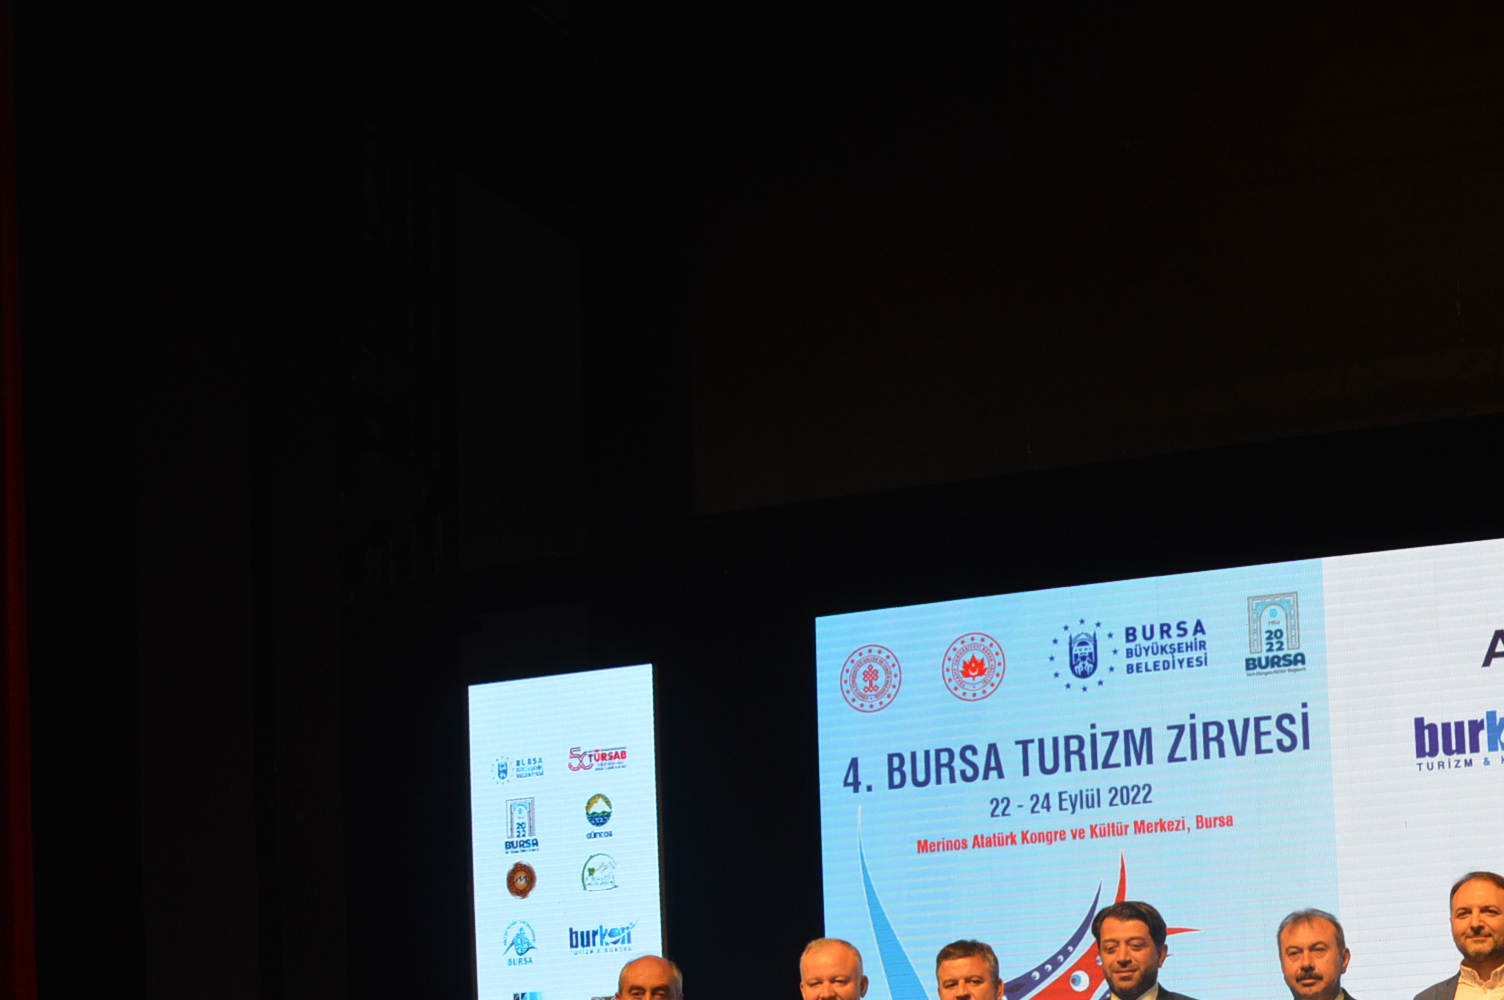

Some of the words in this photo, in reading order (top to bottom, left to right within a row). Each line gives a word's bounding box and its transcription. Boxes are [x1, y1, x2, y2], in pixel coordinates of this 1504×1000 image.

[1125, 619, 1206, 643] BURSA
[1265, 629, 1283, 640] 20
[1126, 637, 1207, 658] BÜYÜKŞEHİR
[1265, 641, 1284, 652] 22
[1126, 652, 1208, 675] BELEDİYESİ
[1245, 652, 1306, 671] BURSA
[588, 749, 627, 762] TÜRSAB
[842, 756, 873, 794] 4.
[887, 743, 1005, 790] BURSA
[1015, 723, 1154, 777] TURİZM
[1166, 702, 1311, 763] ZİRVESİ
[1416, 758, 1474, 772] TURİZM
[1483, 756, 1492, 766] &
[989, 797, 1012, 818] 22
[1030, 793, 1052, 815] 24
[1058, 787, 1102, 815] Eylül
[1108, 783, 1153, 808] 2022
[917, 833, 969, 854] Merinos
[971, 830, 1018, 849] Atatürk
[1020, 827, 1067, 847] Kongre
[1070, 828, 1086, 841] ve
[1089, 821, 1130, 839] Kültür
[1133, 816, 1191, 836] Merkezi,
[1195, 812, 1234, 830] Bursa
[504, 838, 539, 850] BURSA
[507, 957, 533, 966] BURSA
